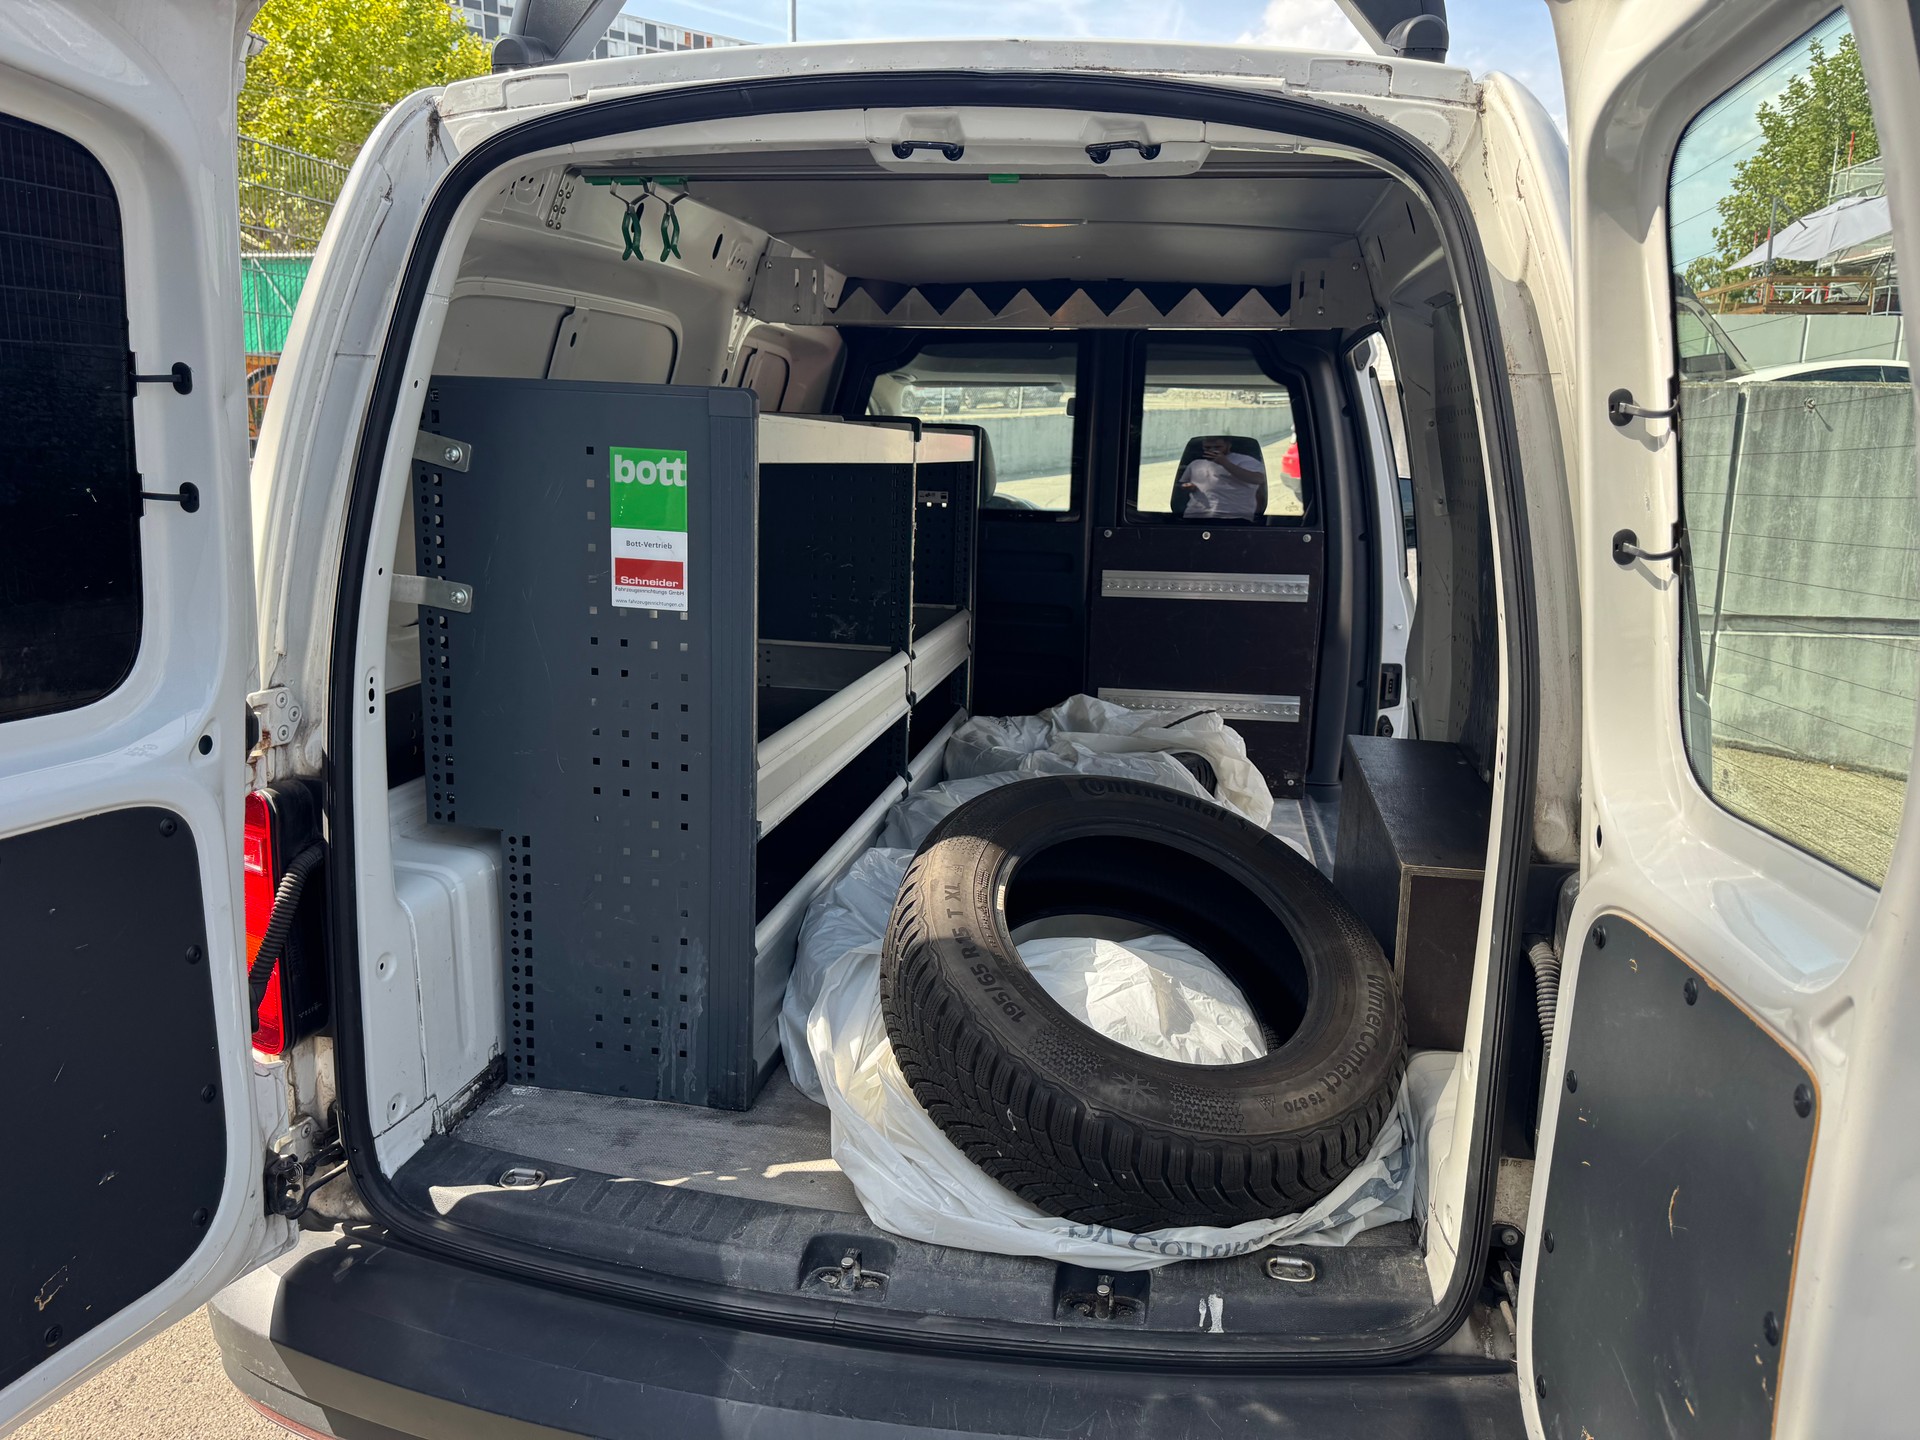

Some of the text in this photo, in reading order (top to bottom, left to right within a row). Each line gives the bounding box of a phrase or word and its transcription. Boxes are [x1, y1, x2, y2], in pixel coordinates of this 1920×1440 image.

[614, 454, 687, 487] bott
[626, 540, 673, 550] Bott-Vertrieb
[620, 575, 679, 588] Schneider
[1078, 777, 1229, 823] Continental
[944, 884, 961, 901] XL
[946, 909, 964, 919] T
[970, 963, 1026, 1023] 195/65
[1319, 974, 1387, 1095] WinterContact
